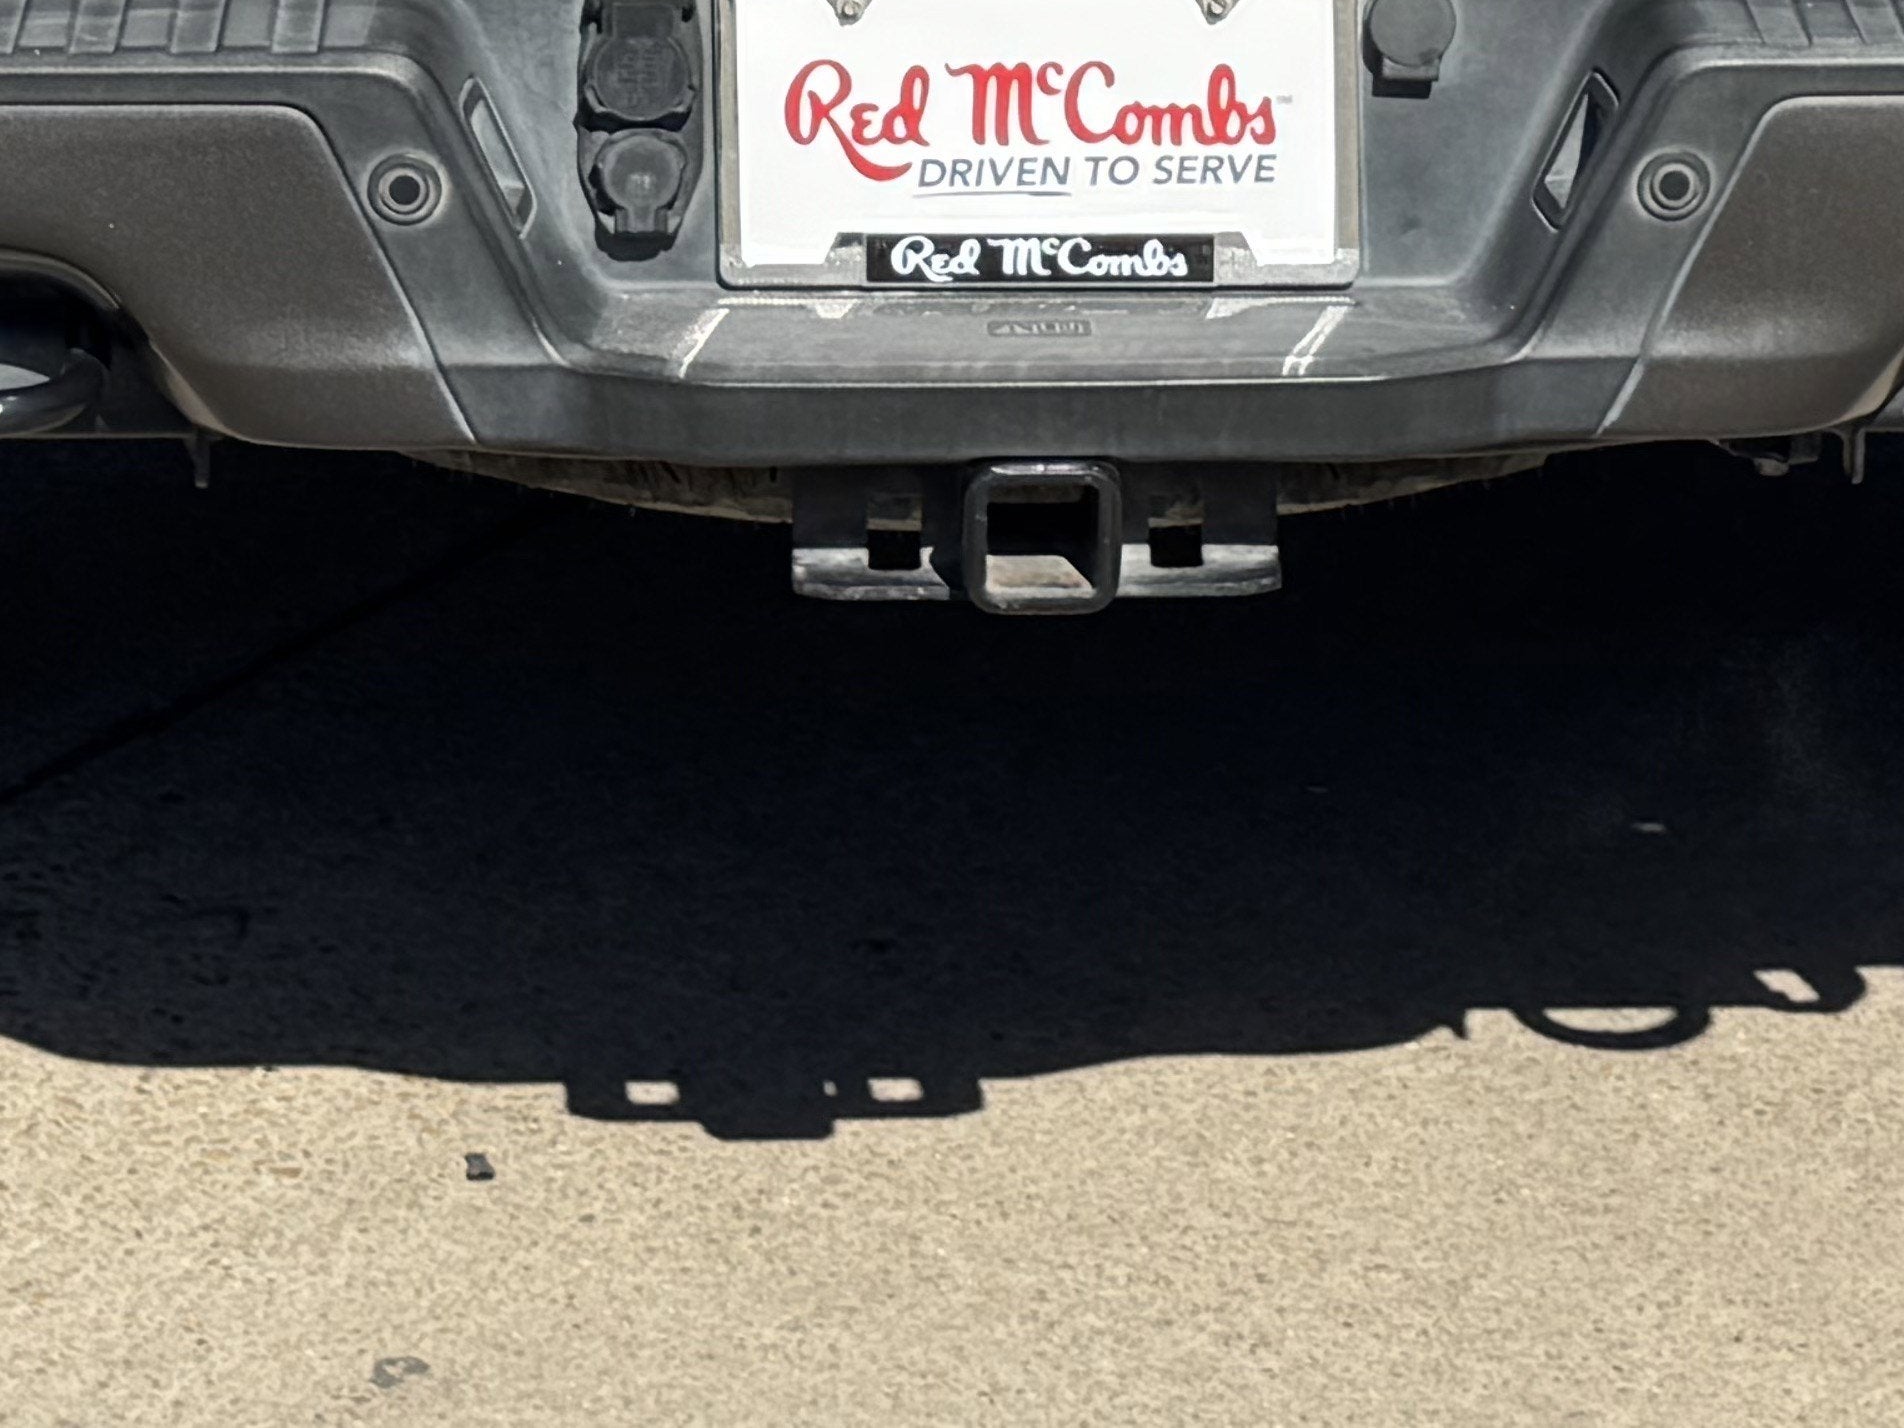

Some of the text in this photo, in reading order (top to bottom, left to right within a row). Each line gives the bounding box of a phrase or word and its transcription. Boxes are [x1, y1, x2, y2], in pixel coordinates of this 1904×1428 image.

[784, 58, 1277, 181] Red McCombs
[917, 153, 1278, 188] DRIVEN TO SERVE
[891, 235, 1189, 282] Red McCombs
